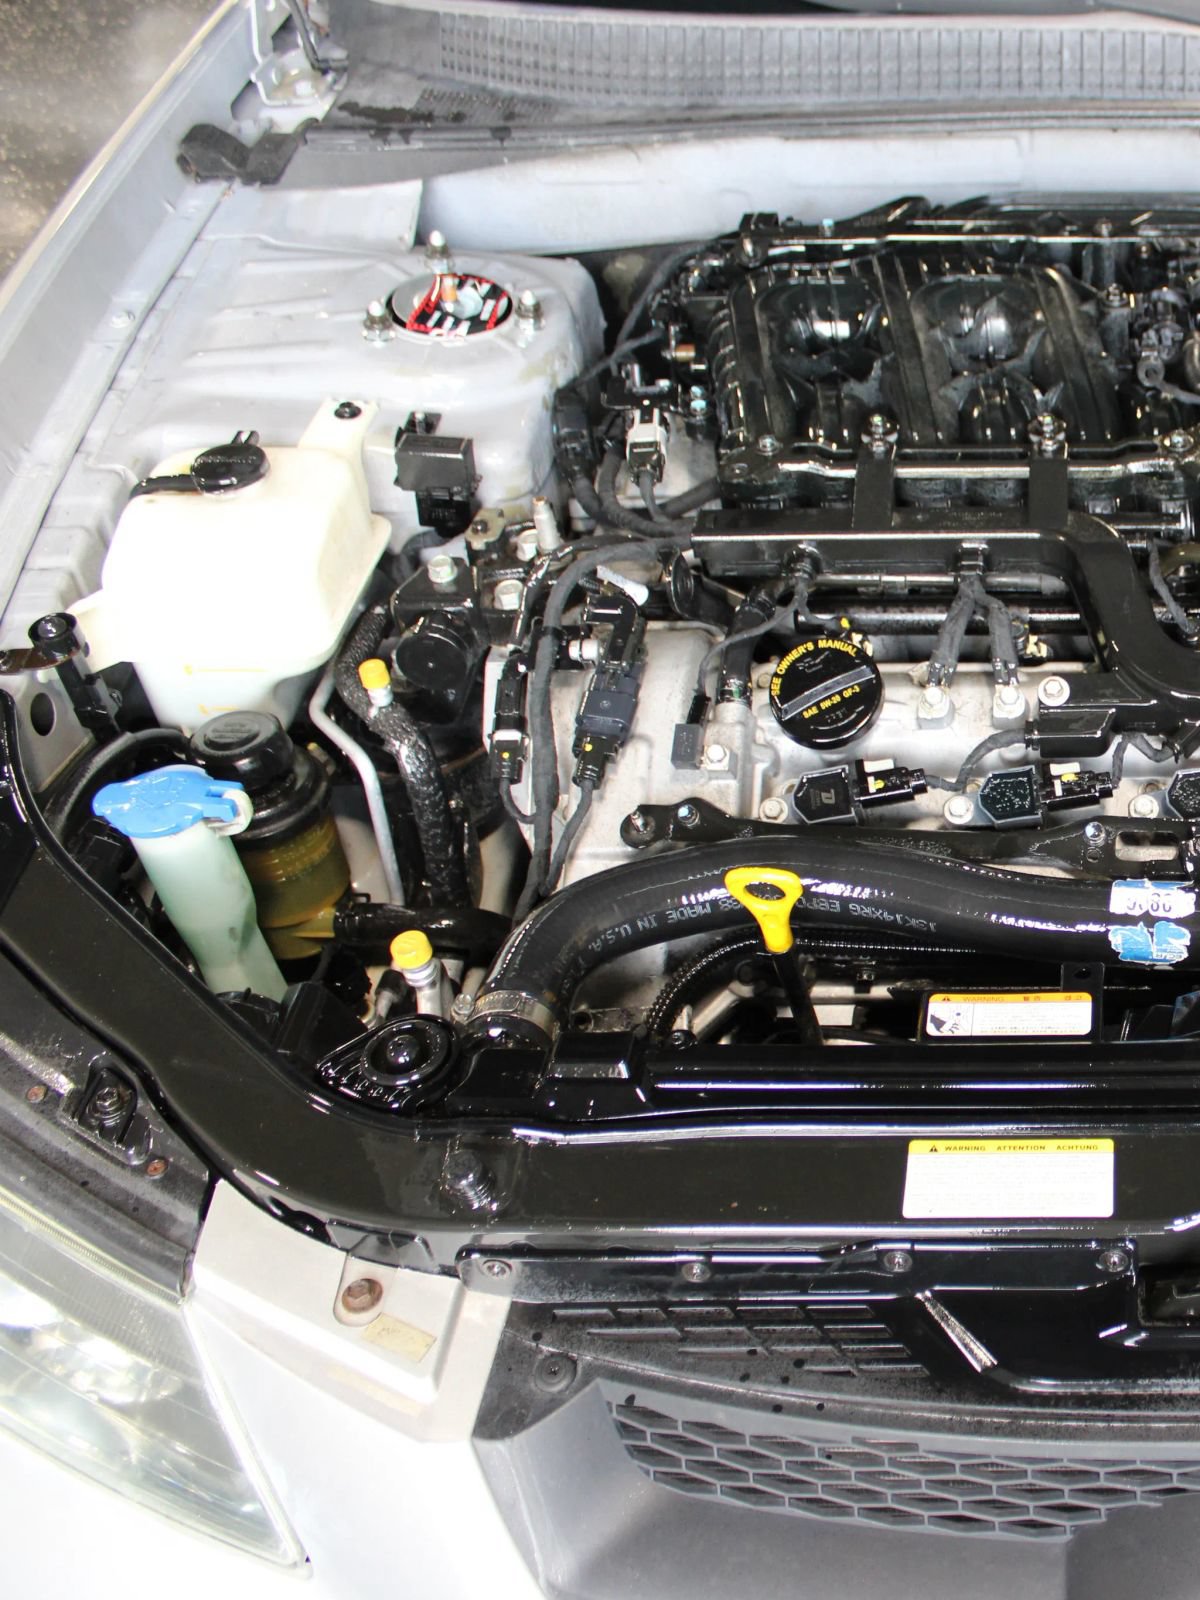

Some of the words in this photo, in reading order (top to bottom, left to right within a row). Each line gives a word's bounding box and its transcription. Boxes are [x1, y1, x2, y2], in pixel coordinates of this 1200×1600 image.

[818, 639, 858, 657] MANUAL
[776, 642, 815, 675] OWNER'S
[771, 677, 782, 697] SEE
[802, 706, 819, 718] SAE
[842, 685, 860, 698] GF-3
[636, 913, 659, 931] IN
[665, 902, 713, 923] MADE
